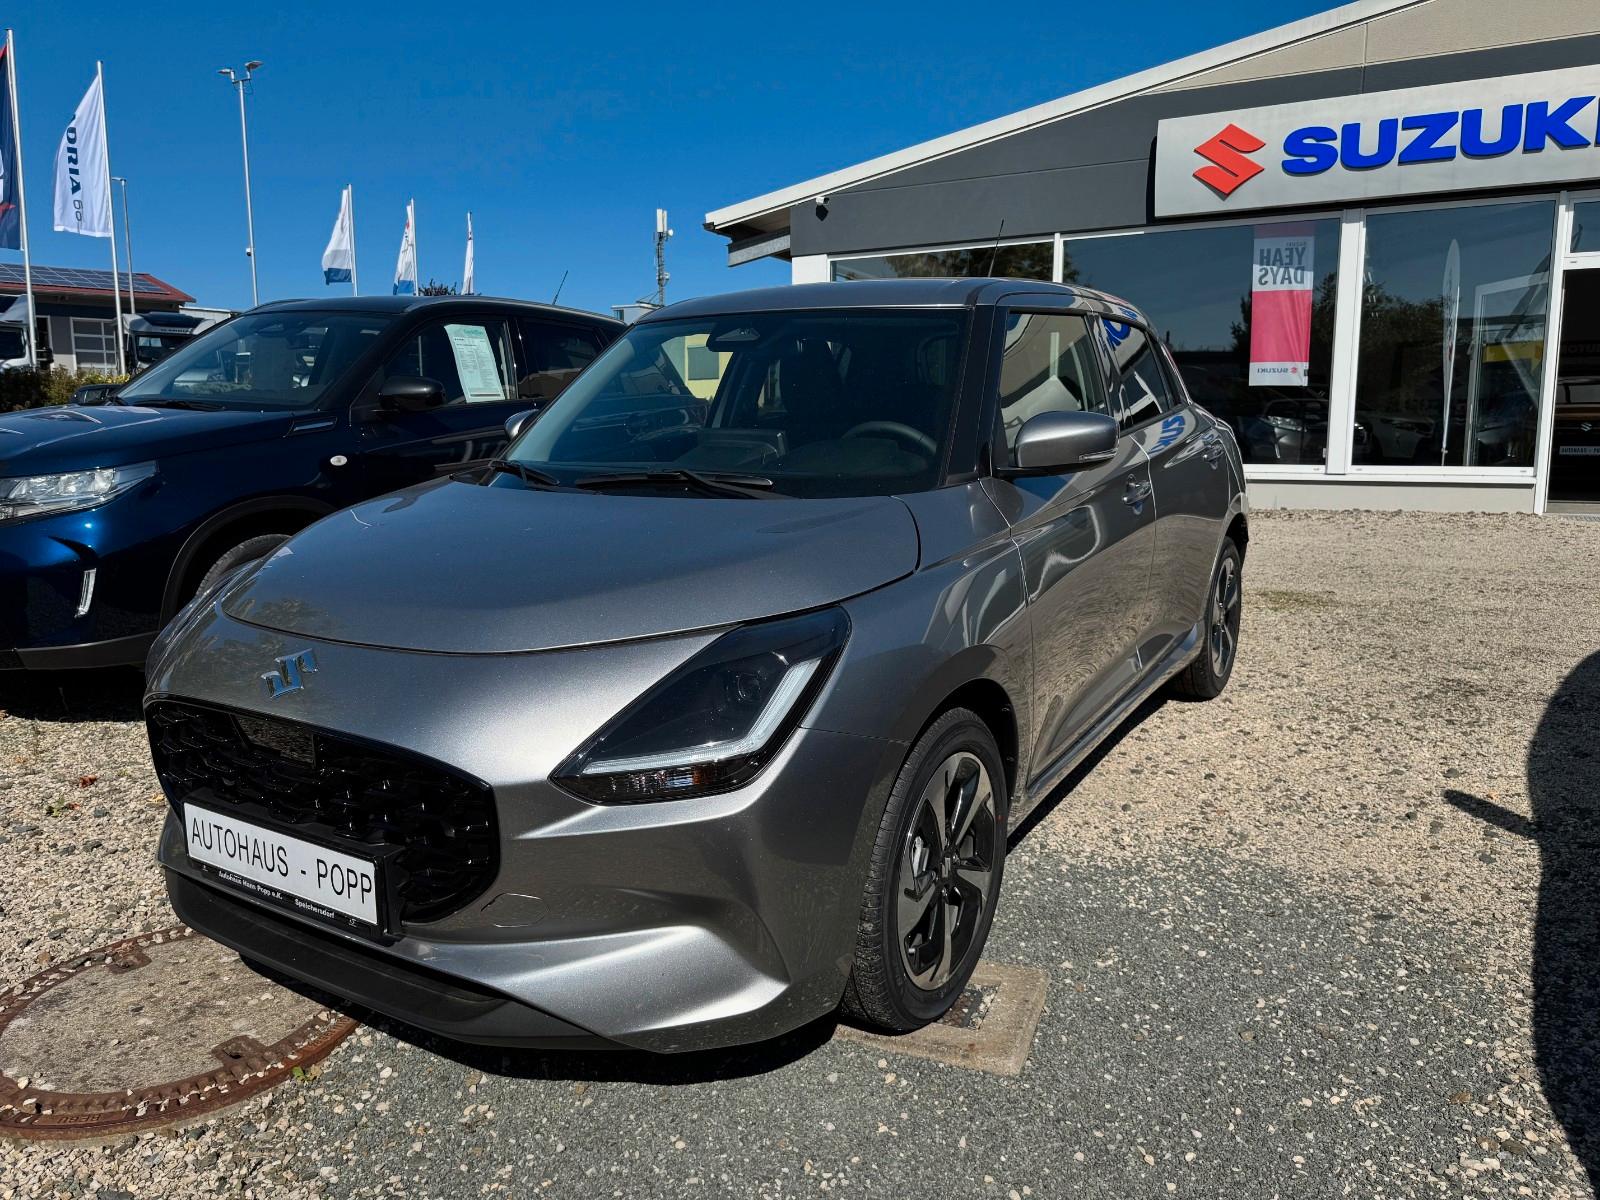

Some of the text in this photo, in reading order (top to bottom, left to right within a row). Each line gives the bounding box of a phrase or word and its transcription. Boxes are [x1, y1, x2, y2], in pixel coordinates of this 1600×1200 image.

[1281, 95, 1600, 175] SUZUK
[191, 817, 289, 877] AUTOHAUS
[316, 858, 372, 904] POPP
[294, 898, 335, 919] Speichersdorf
